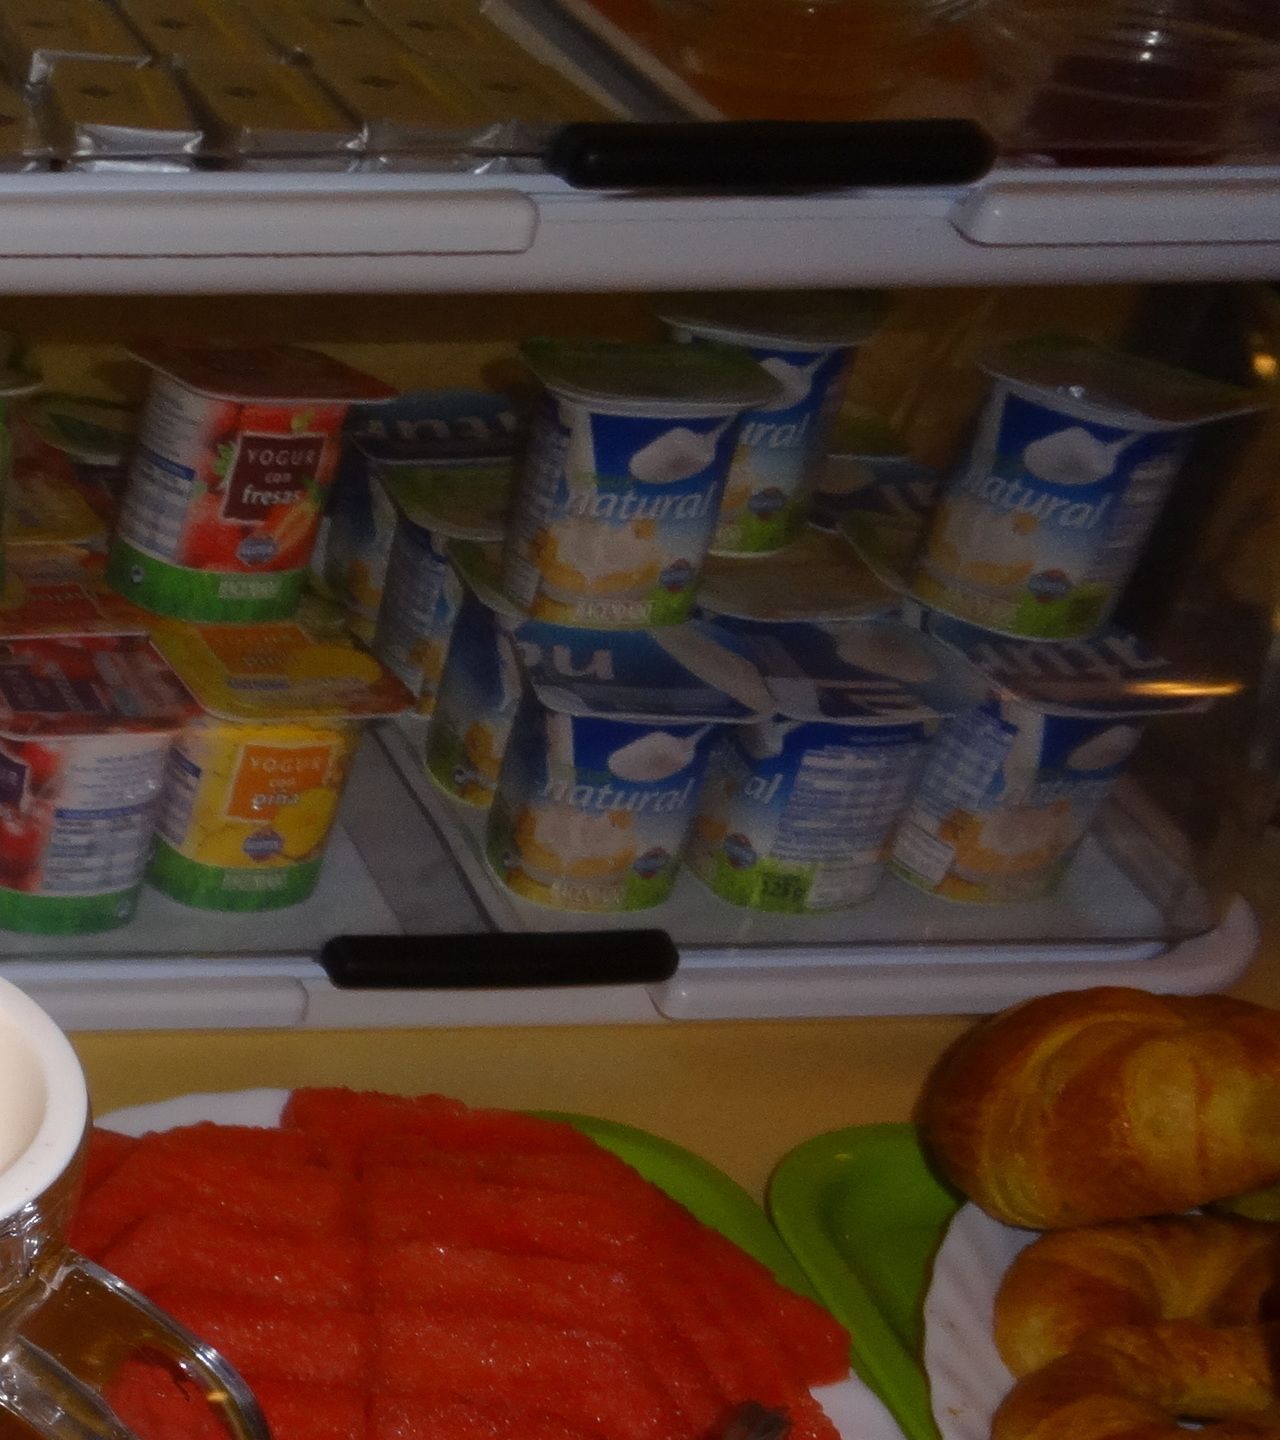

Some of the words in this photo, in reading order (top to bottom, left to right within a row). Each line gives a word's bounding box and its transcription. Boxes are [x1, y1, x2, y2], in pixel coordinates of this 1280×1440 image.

[246, 448, 316, 467] YOGUR
[563, 479, 717, 521] natural
[963, 474, 1113, 530] natural
[537, 776, 696, 814] natural
